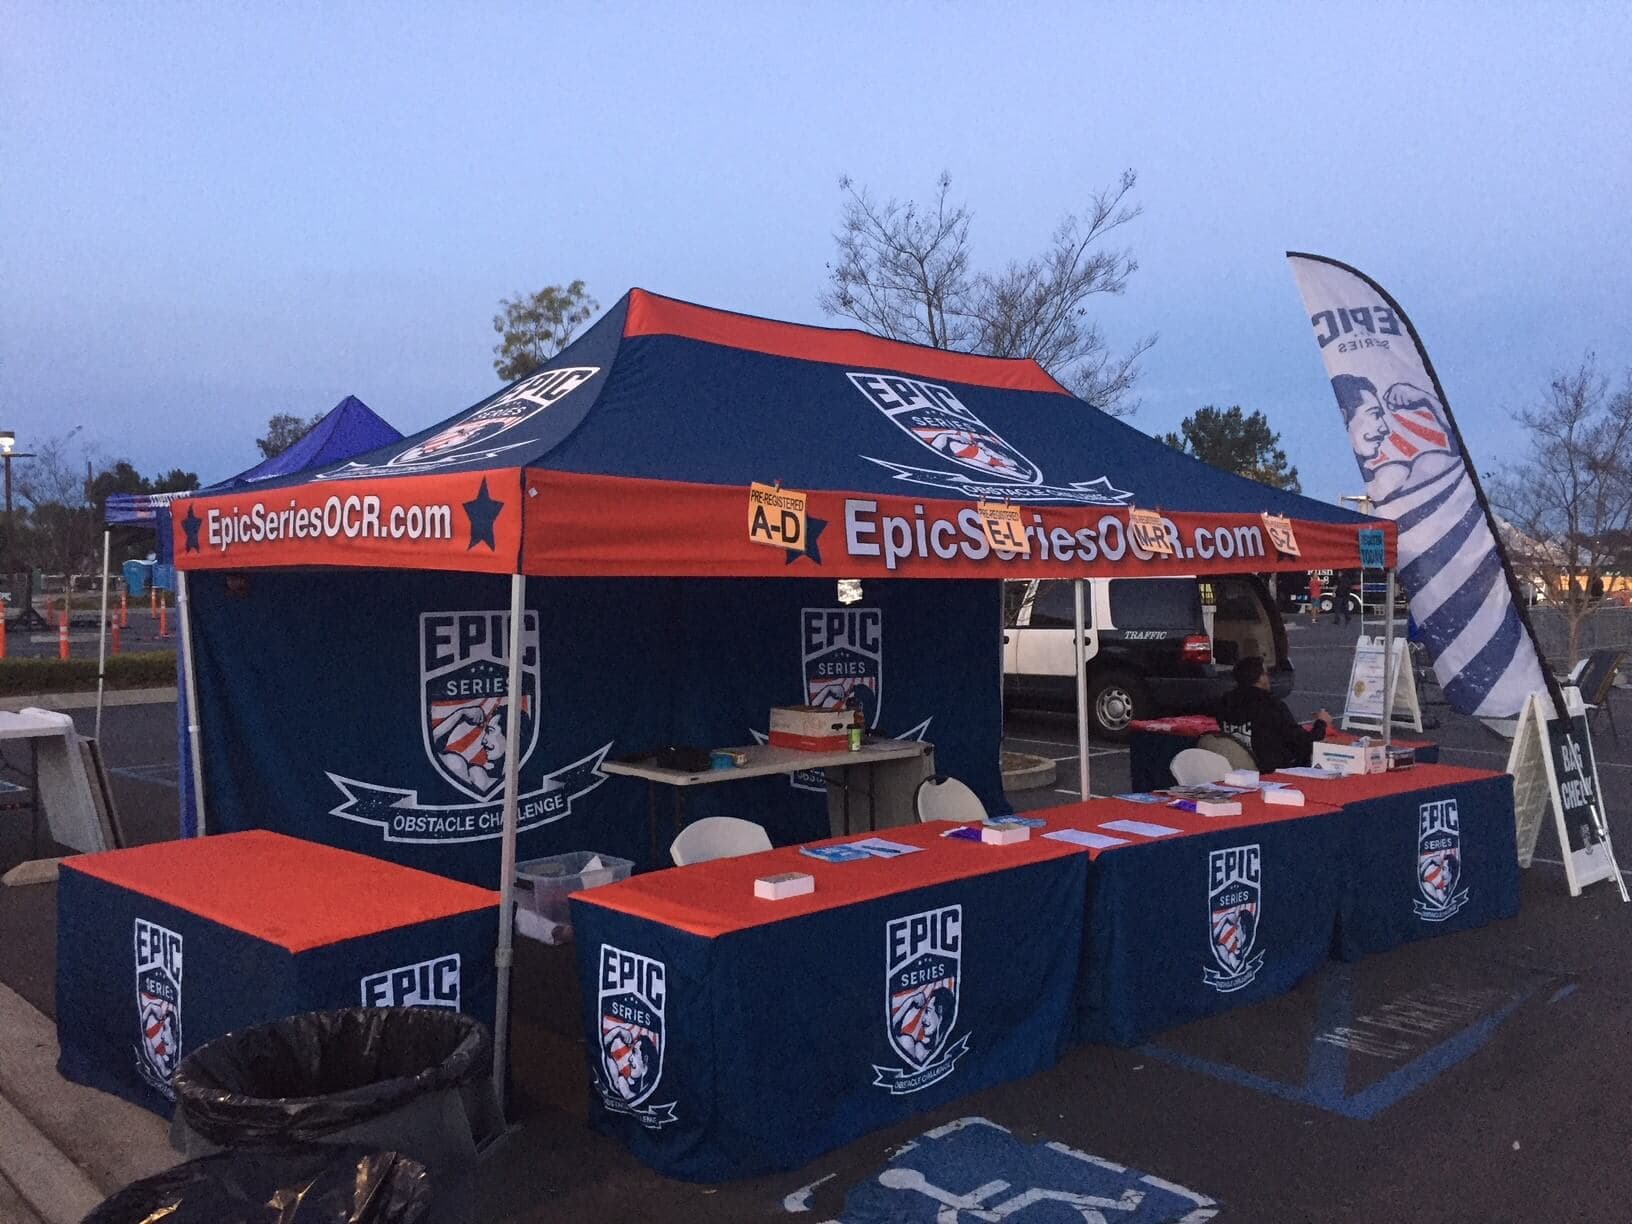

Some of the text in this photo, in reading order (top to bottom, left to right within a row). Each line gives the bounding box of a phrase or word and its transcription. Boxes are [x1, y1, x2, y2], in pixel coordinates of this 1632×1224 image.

[856, 376, 965, 415] EPIC
[911, 416, 975, 433] SERIES
[963, 485, 1050, 497] OBSTACLE
[208, 495, 452, 551] EpicSeriesOCR.com
[751, 505, 800, 544] A-D
[986, 520, 1024, 547] E-L
[1134, 523, 1170, 549] M-R
[1270, 527, 1297, 551] S-Z
[805, 611, 880, 656] EPIC
[1124, 630, 1168, 641] TRAFFIC
[818, 661, 866, 676] SERIES
[1561, 742, 1584, 772] BAG
[393, 814, 475, 832] OBSTACLE
[1421, 801, 1458, 837] EPIC
[1424, 838, 1452, 850] SERIES
[1211, 848, 1260, 892] EPIC
[1219, 890, 1249, 907] SERIES
[136, 921, 182, 984] EPIC
[889, 908, 960, 971] EPIC
[365, 958, 458, 1008] EPIC
[602, 948, 663, 1010] EPIC
[901, 963, 945, 987] SERIES
[611, 1002, 651, 1026] SERIES
